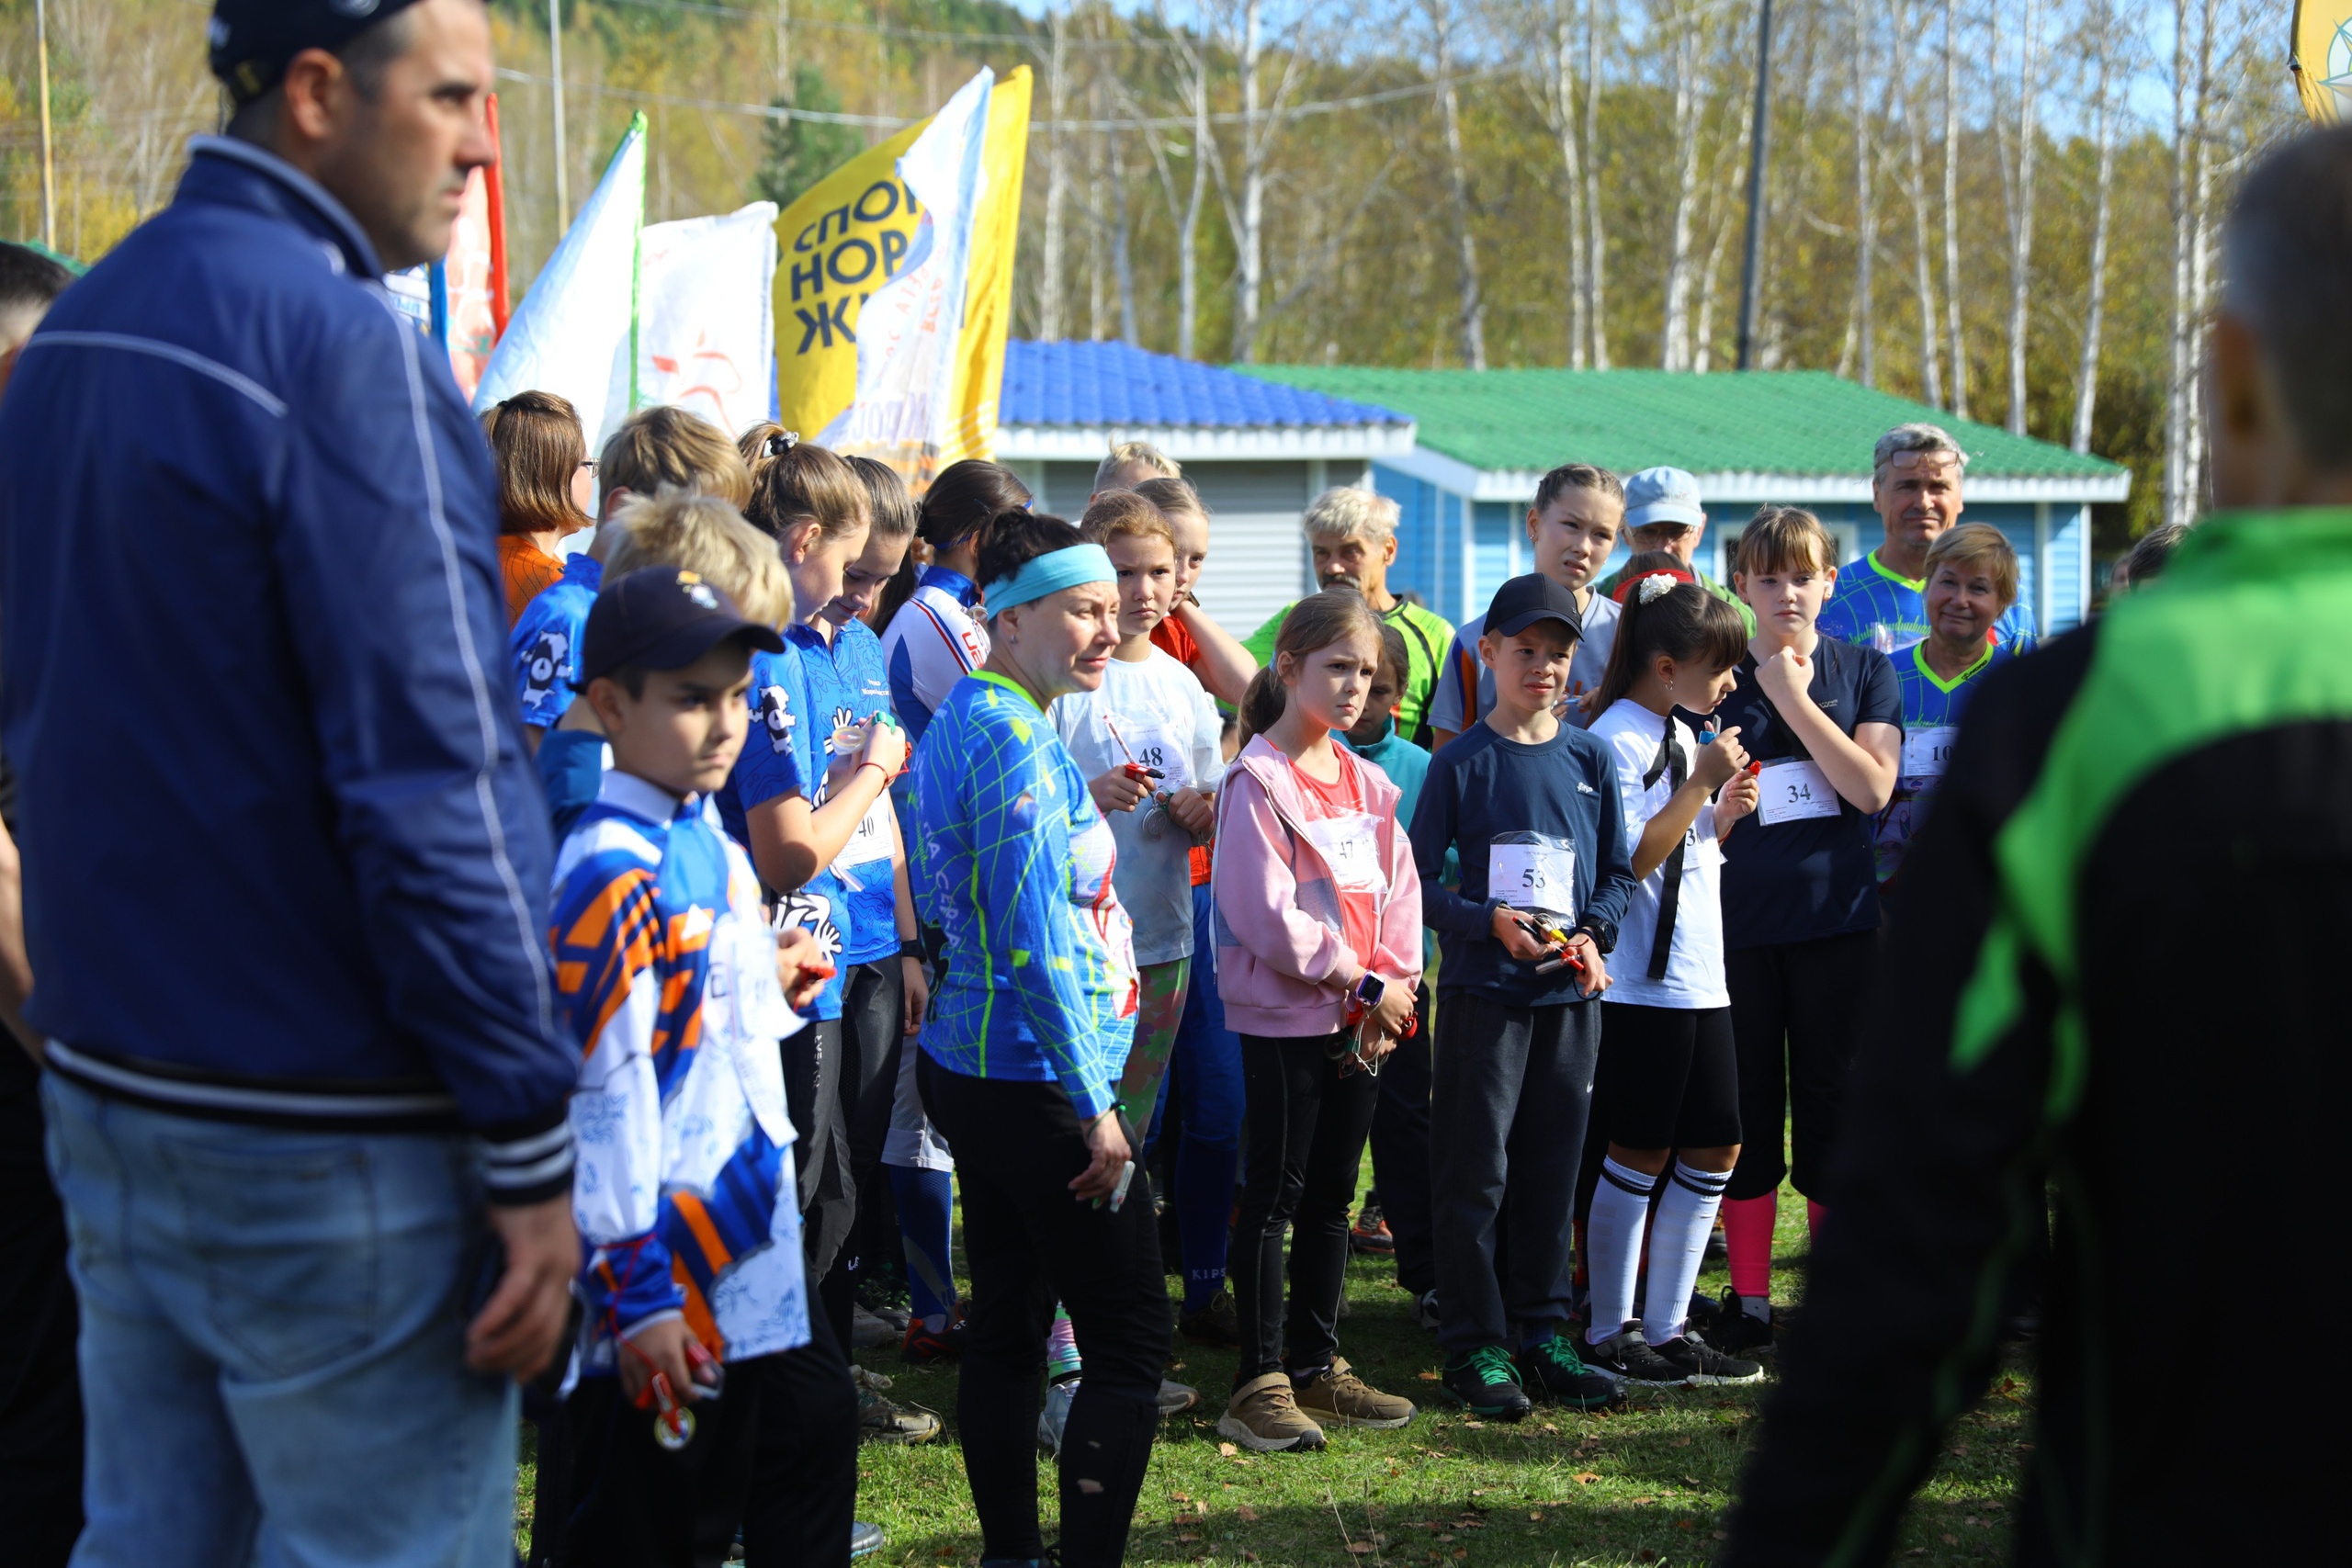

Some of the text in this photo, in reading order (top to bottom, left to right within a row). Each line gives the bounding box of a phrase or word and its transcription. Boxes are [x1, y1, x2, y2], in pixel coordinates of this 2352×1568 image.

[1139, 747, 1163, 766] 48
[1787, 783, 1811, 804] 34
[858, 816, 875, 837] 40
[1521, 868, 1546, 889] 53
